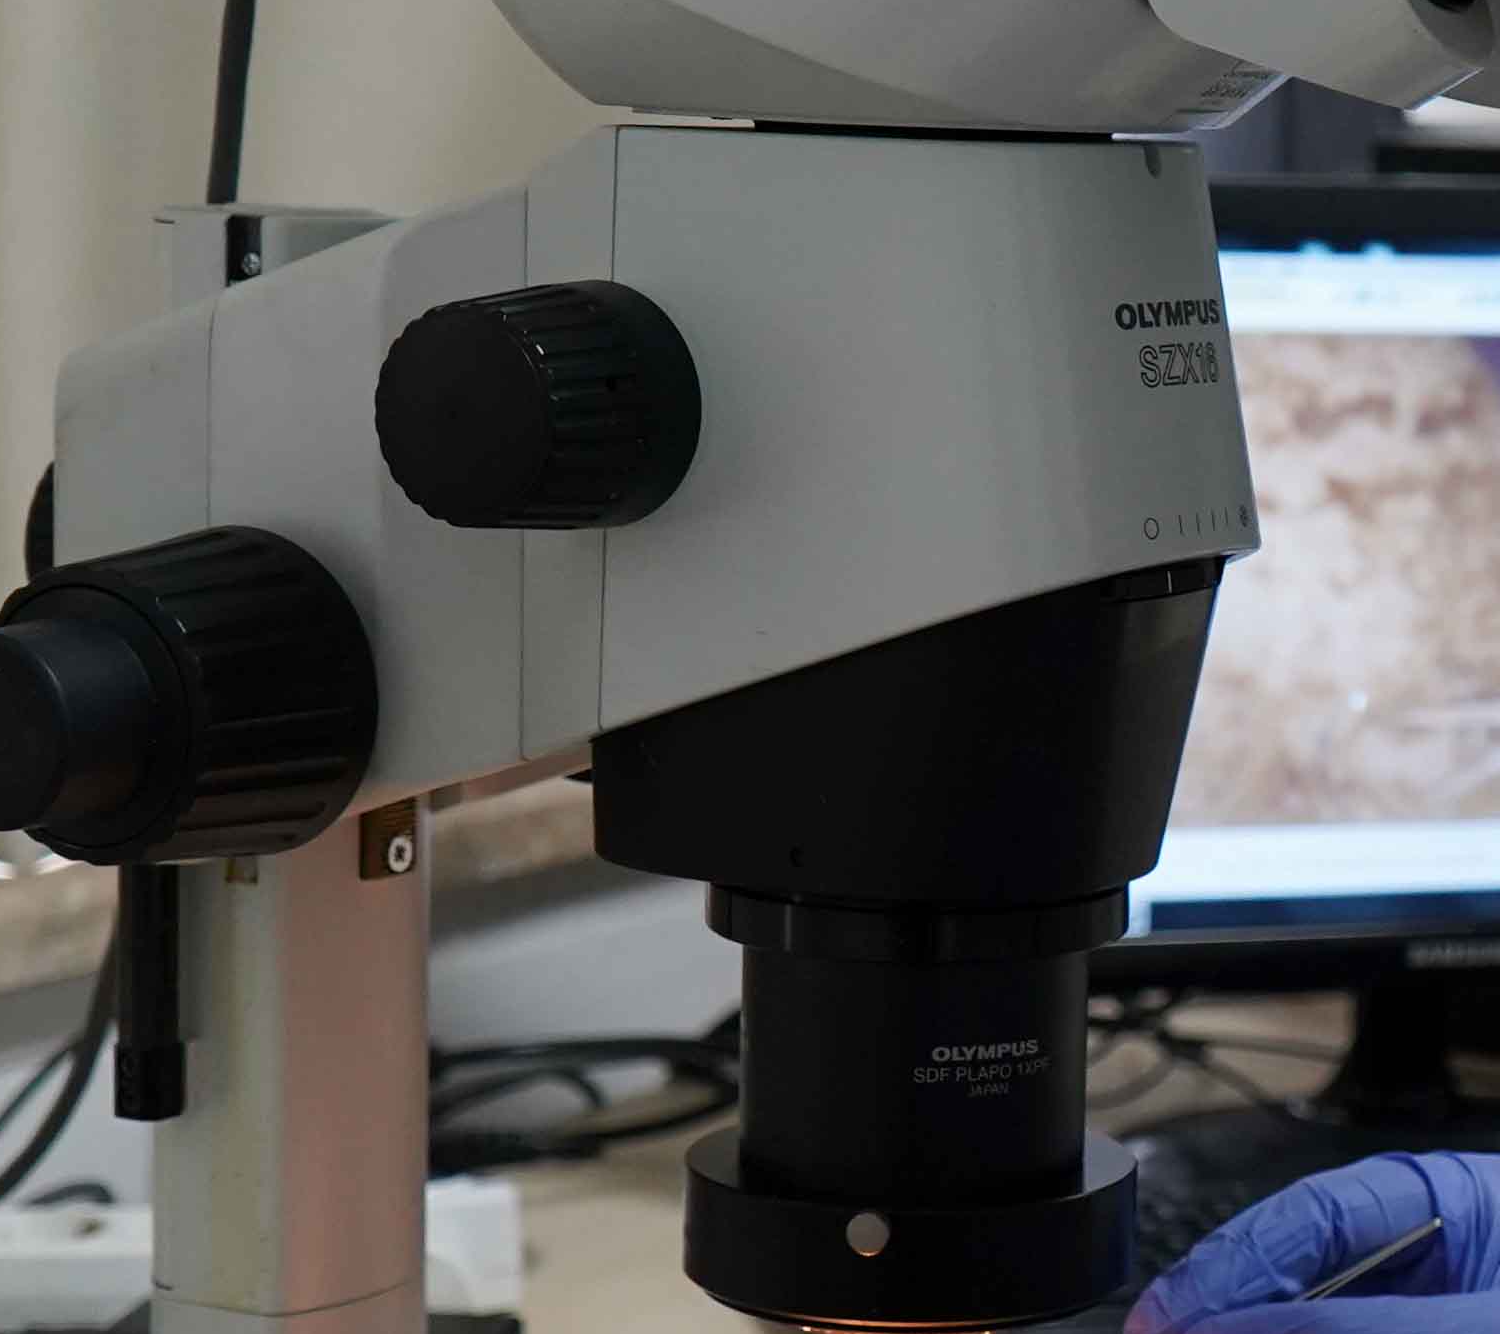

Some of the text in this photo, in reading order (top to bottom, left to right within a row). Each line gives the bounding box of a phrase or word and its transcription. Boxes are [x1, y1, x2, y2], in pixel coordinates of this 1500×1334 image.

[1114, 298, 1221, 330] OLYMPUS
[931, 1039, 1038, 1063] OLYMPUS
[913, 1066, 949, 1084] SDF
[955, 1064, 1012, 1082] PLAPO
